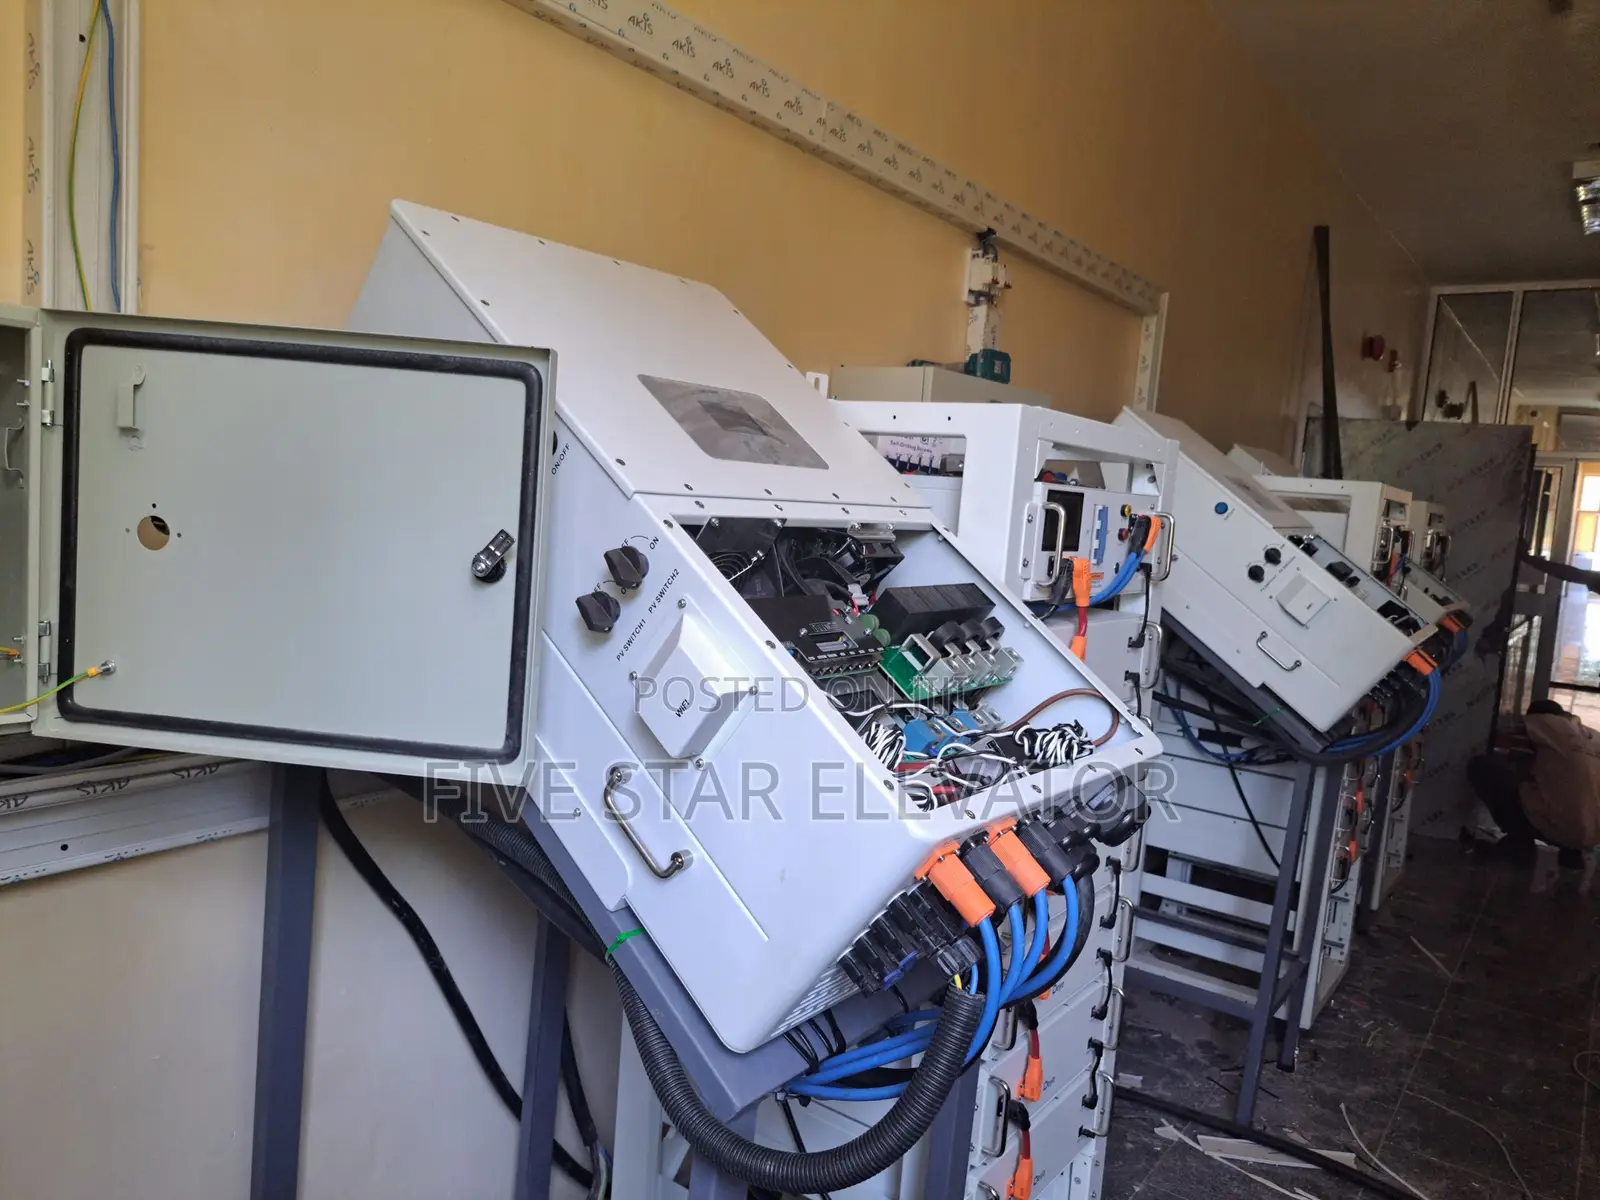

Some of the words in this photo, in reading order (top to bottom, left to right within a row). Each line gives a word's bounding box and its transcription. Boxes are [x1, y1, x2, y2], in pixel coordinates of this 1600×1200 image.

[627, 13, 654, 35] AKIS
[672, 37, 696, 58] AKIS
[712, 59, 734, 79] AKIS
[749, 79, 770, 98] AKIS
[784, 98, 803, 116] AKIS
[26, 239, 40, 295] AKIS
[551, 443, 570, 475] ON/OFF
[649, 536, 660, 550] ON
[648, 602, 657, 614] PV
[655, 568, 679, 603] SWITCH2
[616, 650, 625, 662] PV
[623, 618, 646, 652] SWITCH1
[76, 778, 132, 796] AKIS
